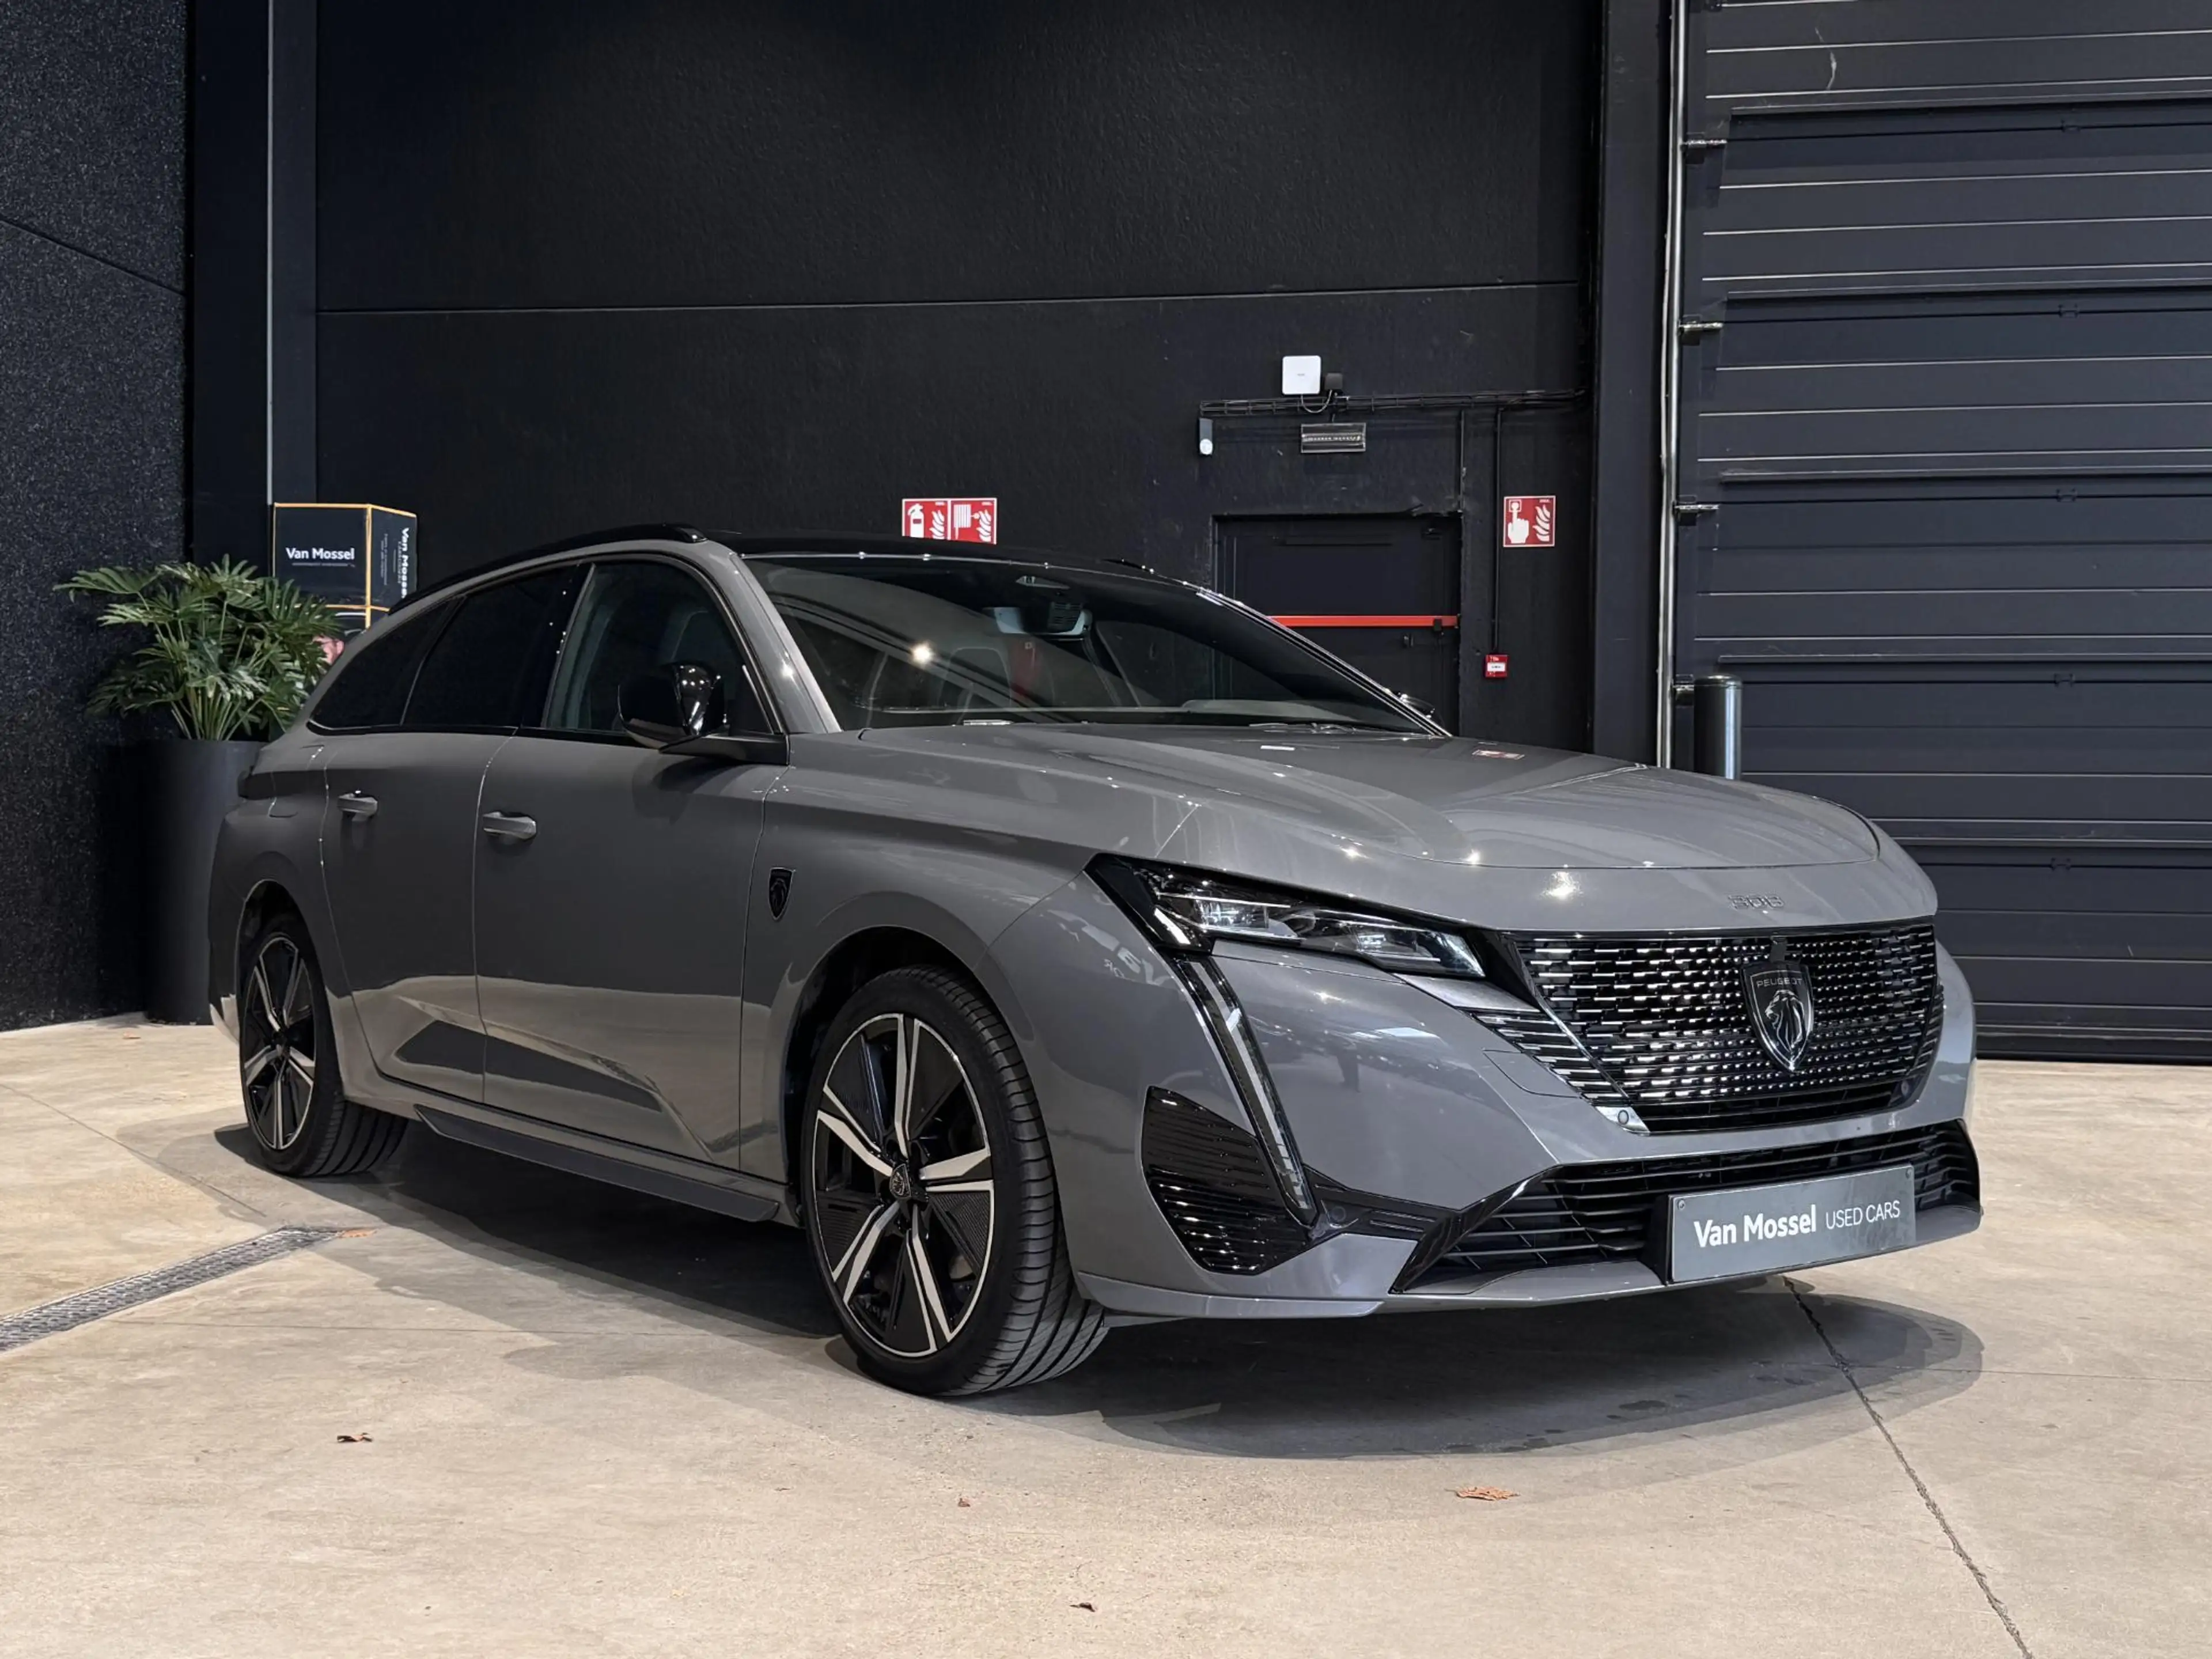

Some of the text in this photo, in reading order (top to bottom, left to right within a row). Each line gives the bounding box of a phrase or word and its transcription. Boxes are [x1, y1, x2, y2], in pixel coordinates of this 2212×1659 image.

[402, 528, 410, 551] Van
[286, 548, 355, 560] Van Mossel
[1756, 978, 1802, 987] PEUGEOT
[1694, 1200, 1900, 1247] Van Mossel USED CARS
